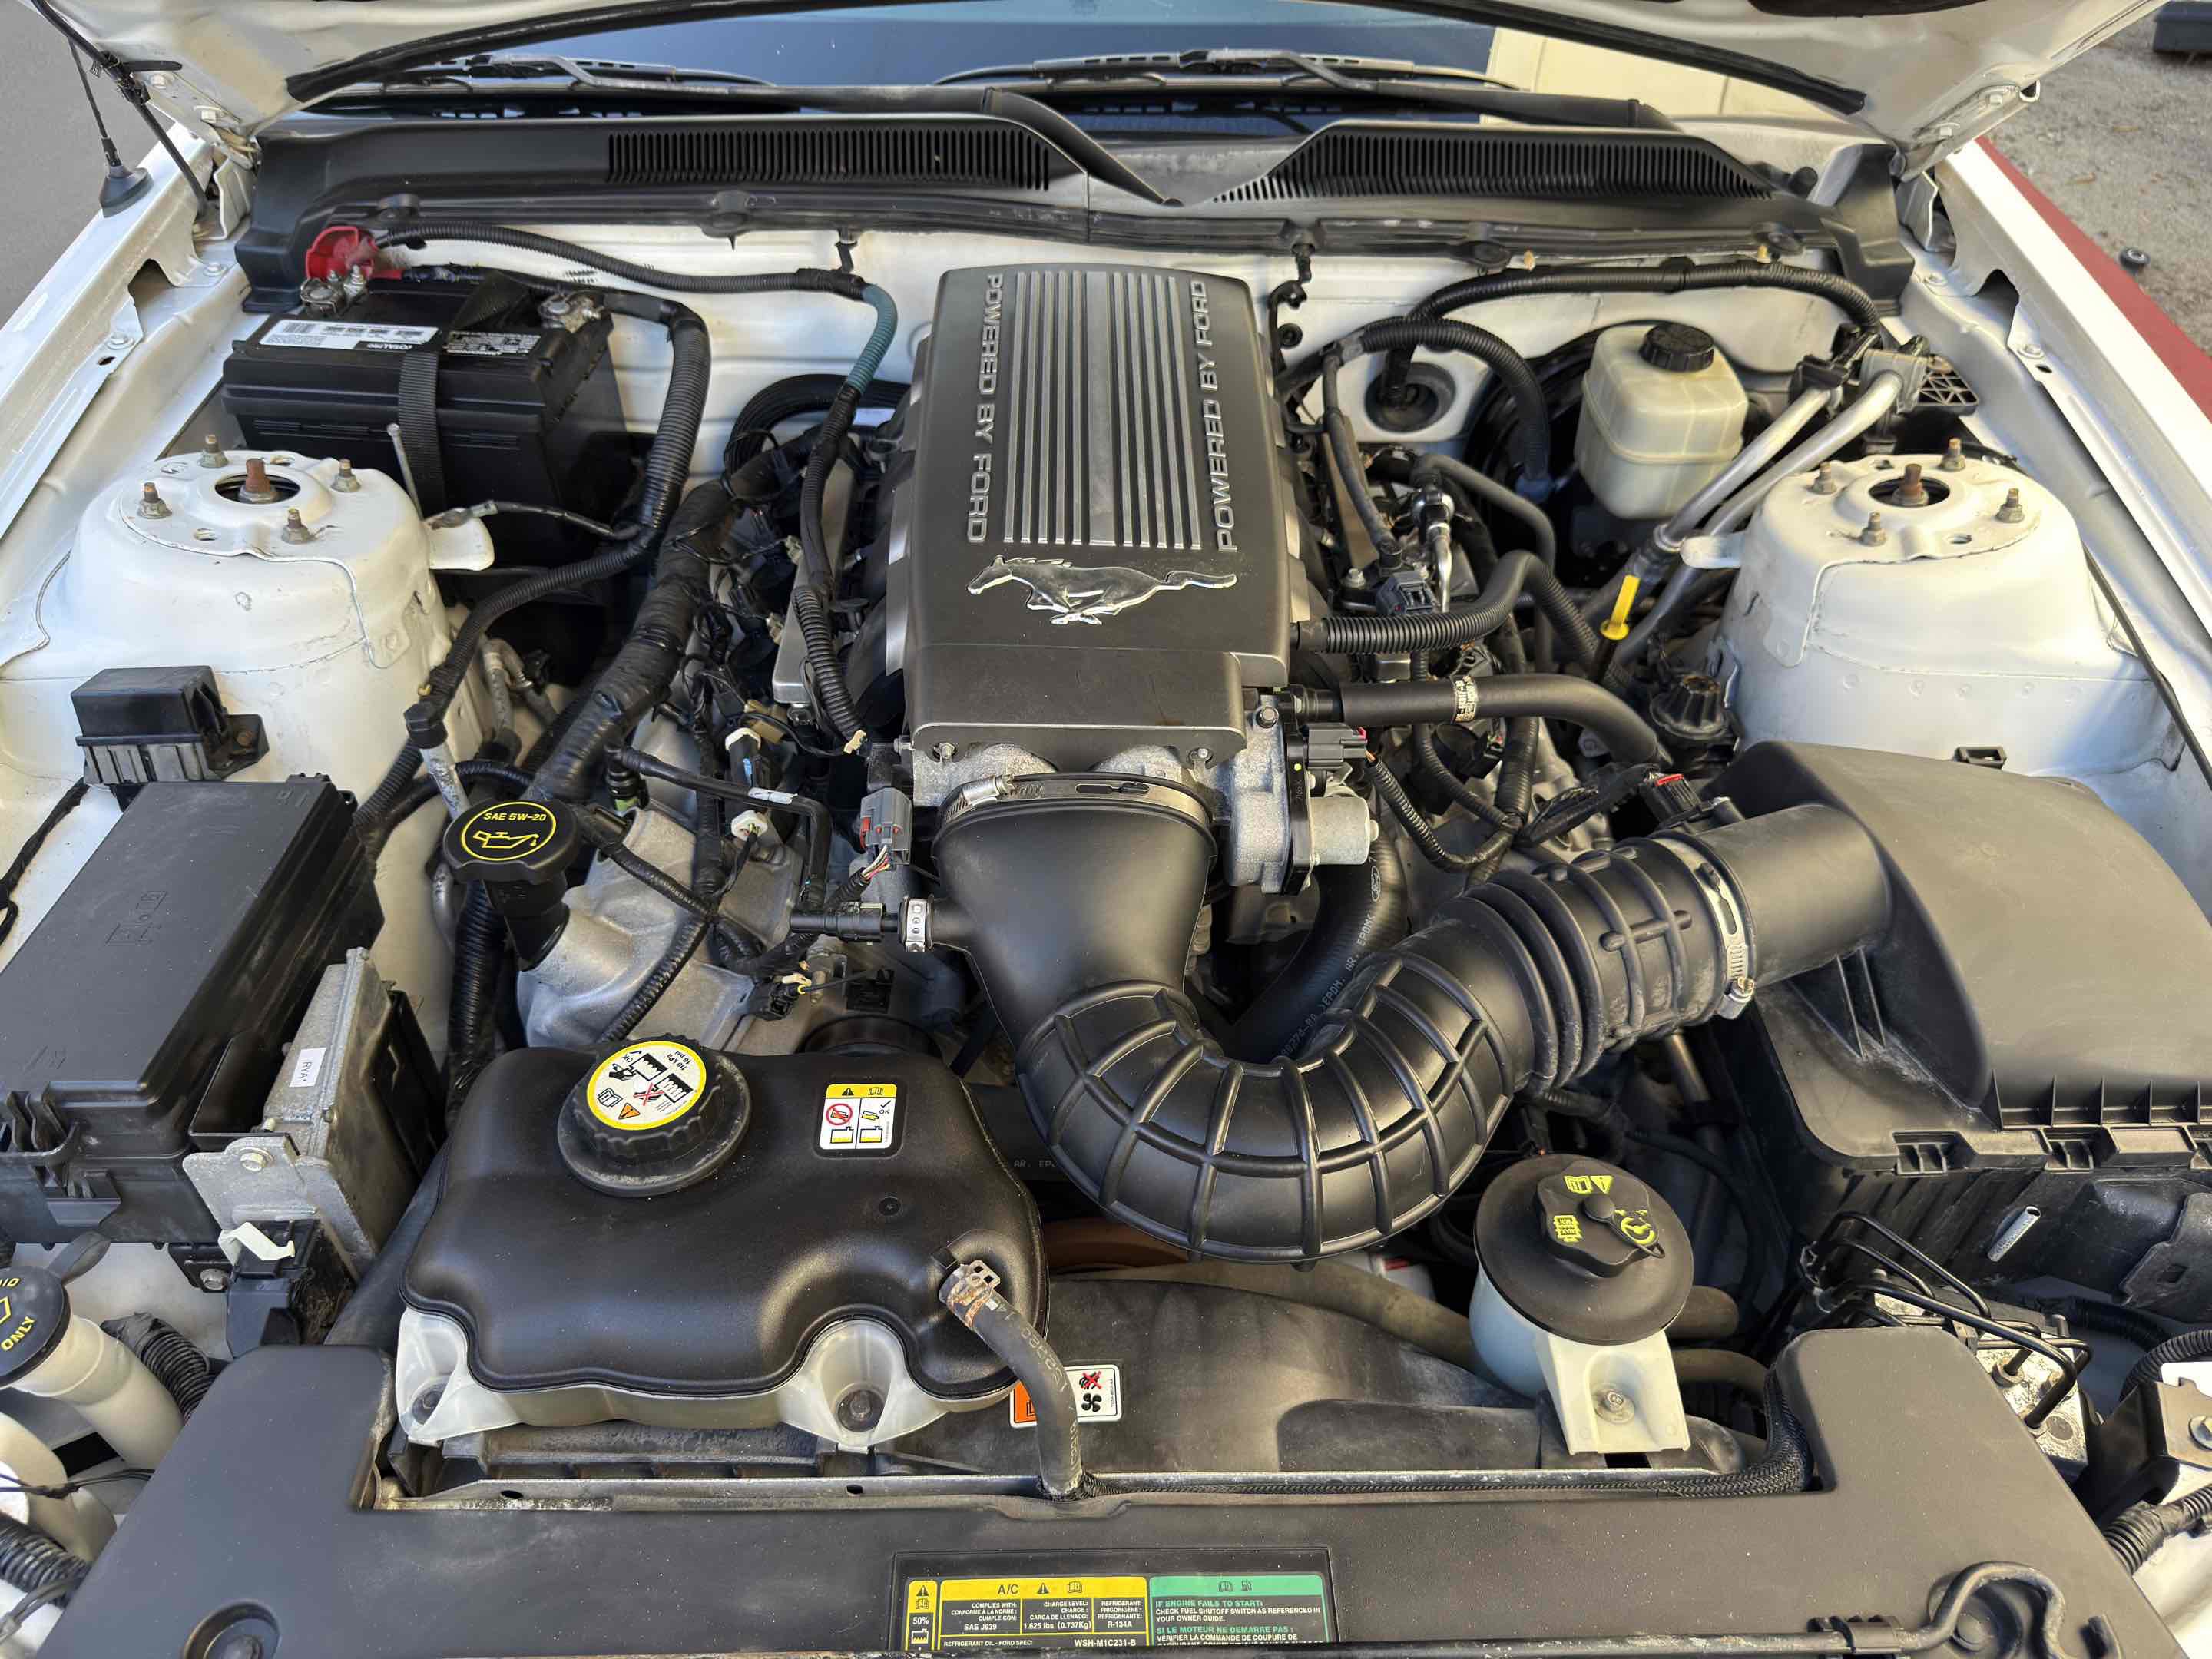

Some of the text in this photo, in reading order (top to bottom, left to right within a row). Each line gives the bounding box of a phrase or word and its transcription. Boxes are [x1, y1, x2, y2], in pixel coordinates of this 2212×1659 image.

[967, 274, 1003, 543] POWERED BY FORD
[1190, 280, 1237, 552] POWERED BY FORD
[483, 813, 507, 821] SAE
[1, 1316, 35, 1352] ONLY
[998, 1584, 1018, 1594] A/C
[912, 1617, 929, 1625] 50%
[1058, 1621, 1091, 1630] (0.737Kg)
[1075, 1639, 1137, 1647] WSH-M1C231-B
